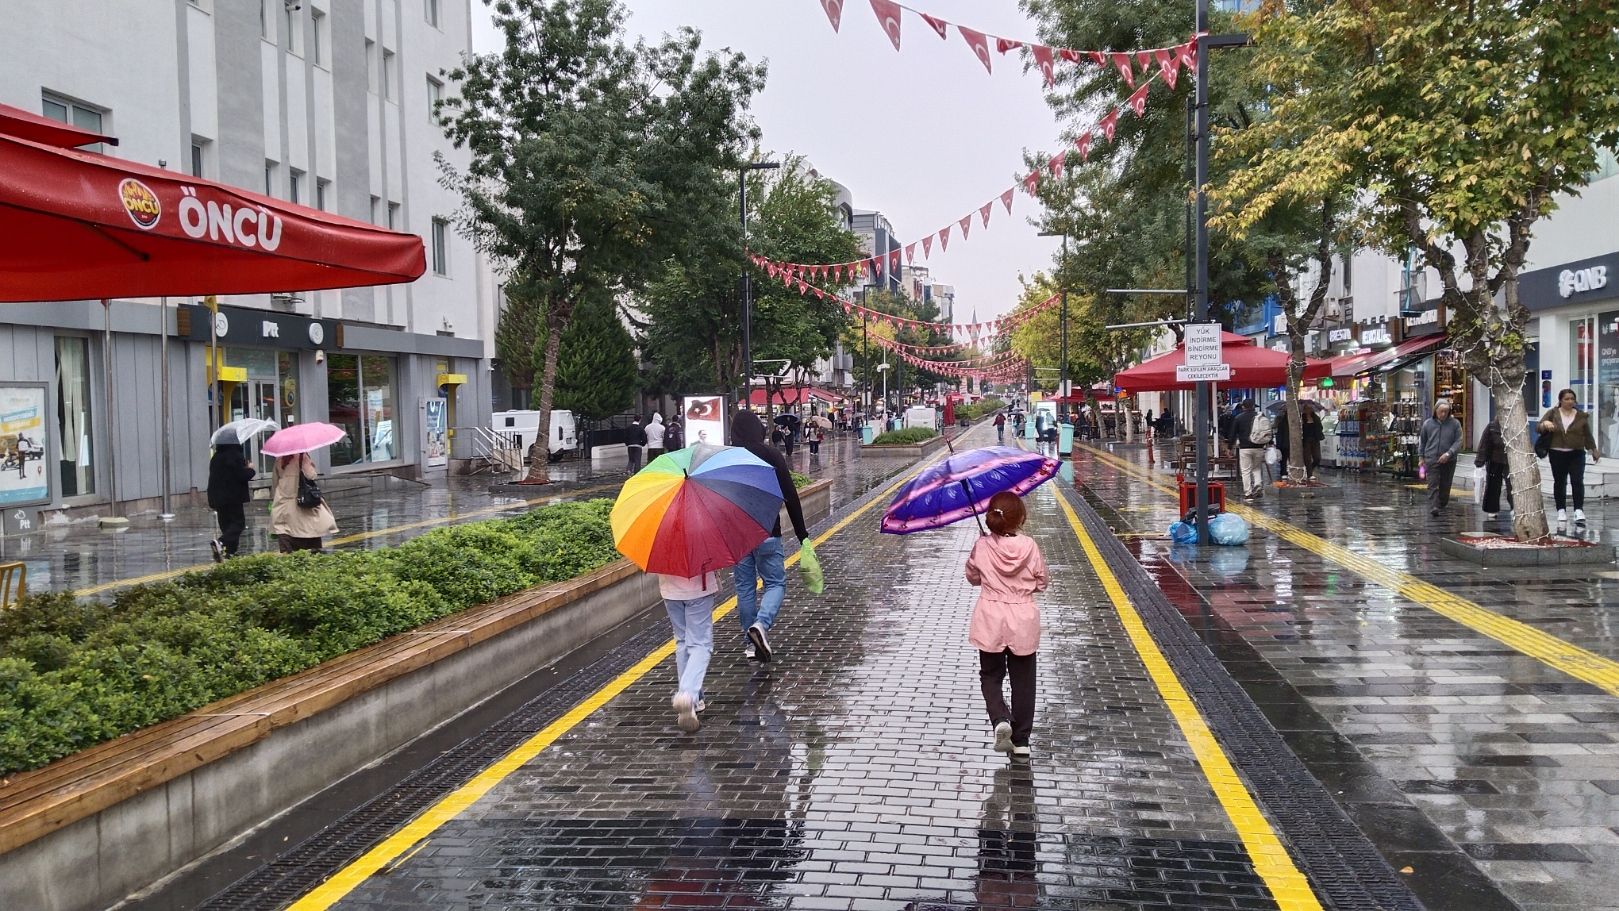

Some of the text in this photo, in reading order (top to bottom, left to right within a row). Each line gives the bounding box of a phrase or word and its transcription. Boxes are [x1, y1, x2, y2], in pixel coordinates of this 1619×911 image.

[178, 185, 283, 252] ÖNCÜ
[1574, 265, 1607, 292] QNB
[20, 519, 31, 530] Ptt
